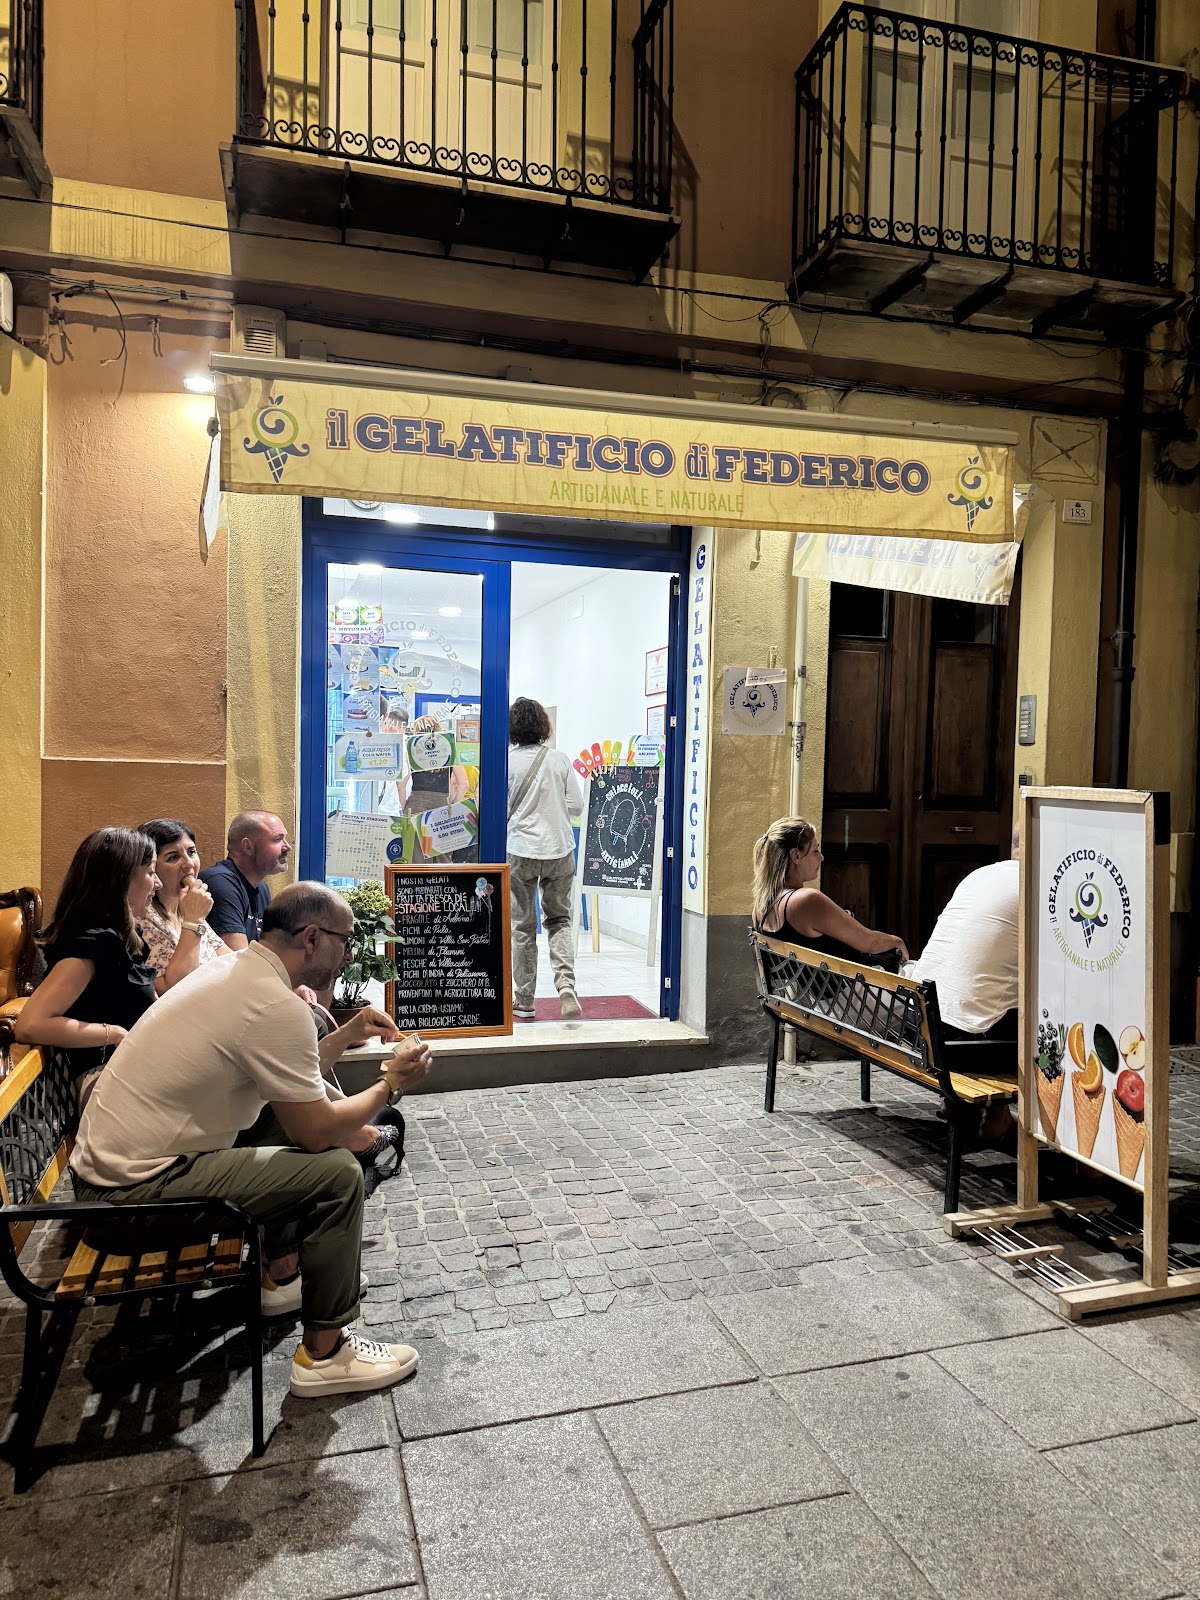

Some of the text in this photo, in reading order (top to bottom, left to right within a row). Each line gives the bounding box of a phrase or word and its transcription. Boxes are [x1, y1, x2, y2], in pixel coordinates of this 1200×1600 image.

[326, 408, 931, 496] il GELATIFICIO di FEDERICO
[549, 480, 744, 513] ARTIGIANALE E NATURALE
[1070, 508, 1086, 518] 183
[688, 544, 706, 890] GELATIFICIO
[400, 877, 424, 885] NOSTRI
[426, 876, 450, 884] GELATI
[397, 887, 414, 896] SONO
[443, 886, 457, 894] CON
[1048, 849, 1096, 914] GELATIFICIO
[1096, 852, 1105, 866] di
[1103, 857, 1131, 939] FEDERICO
[396, 894, 425, 904] FRUTTA
[425, 893, 454, 903] FRESCA
[402, 914, 431, 924] FRAGOLE
[433, 914, 442, 924] di
[402, 926, 421, 935] FICHI
[424, 926, 431, 934] di
[429, 935, 437, 944] di
[402, 947, 425, 956] MELONI
[428, 946, 436, 956] di
[1052, 927, 1127, 973] ARTIGIANALE E NATURALE
[403, 958, 428, 969] PESCHE
[428, 958, 437, 968] di
[403, 969, 420, 979] FICHI
[446, 968, 455, 978] di
[439, 979, 444, 987] E
[445, 978, 476, 987] ZUCCHERO
[444, 988, 483, 998] AGRICOLTURA
[409, 1004, 417, 1014] LA
[398, 1018, 417, 1029] UOVA
[418, 1015, 457, 1027] BIOLOGICHE
